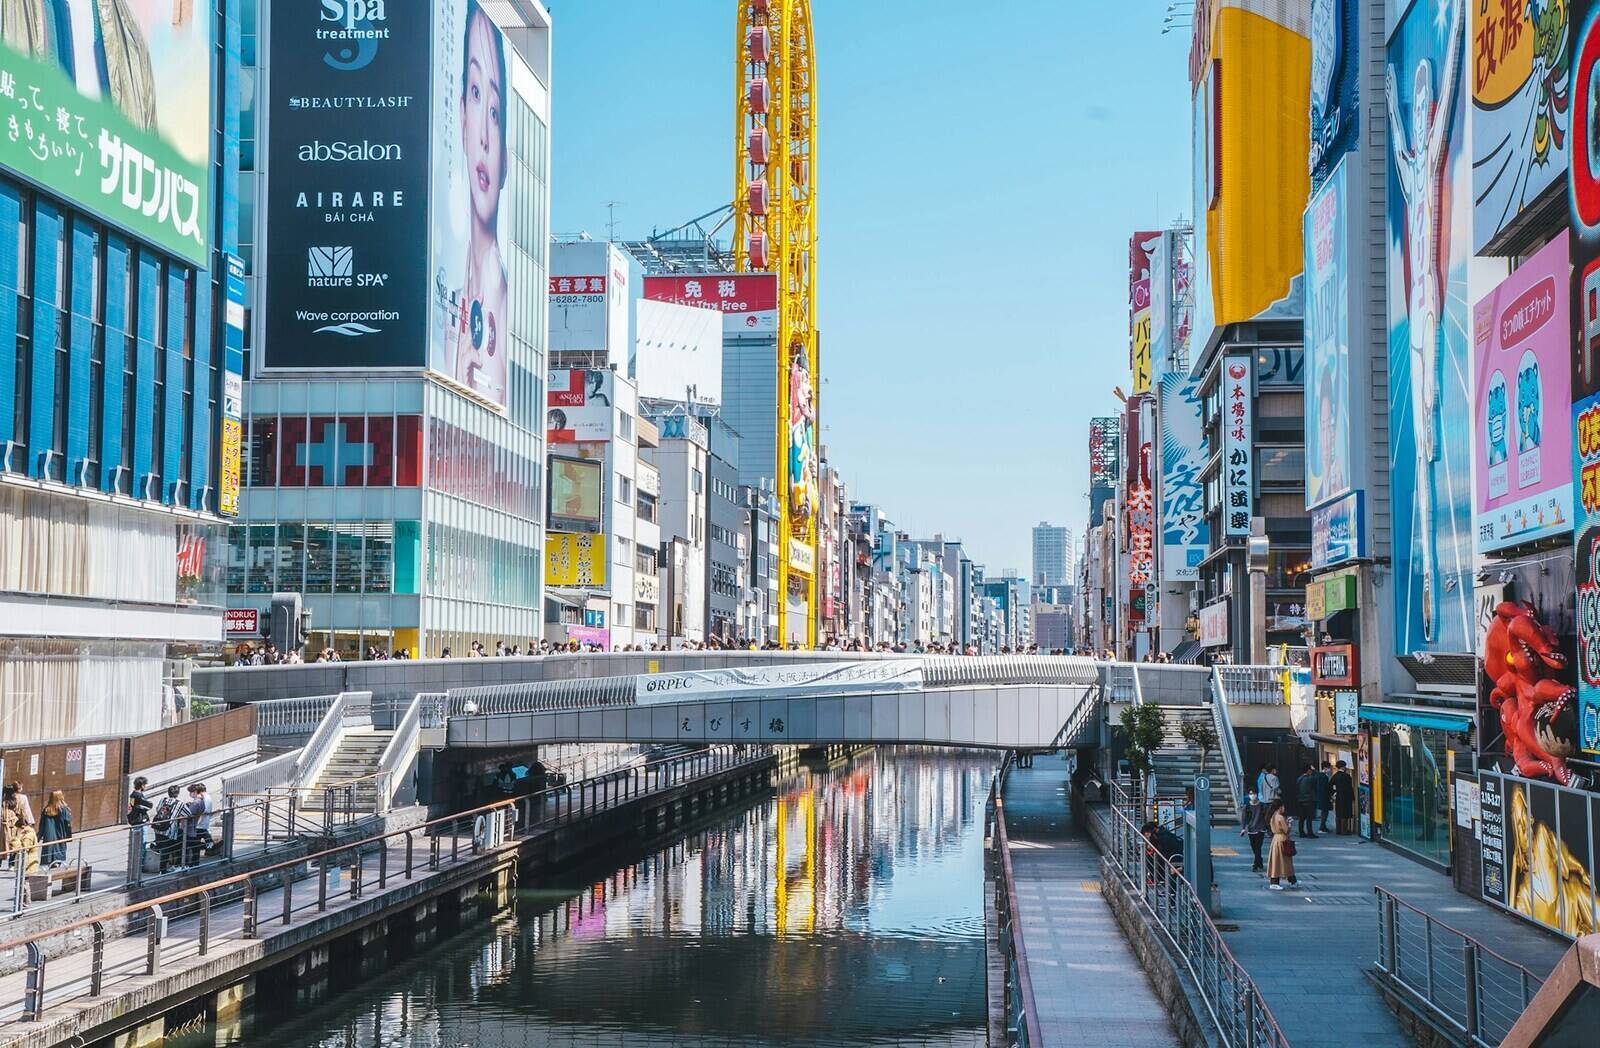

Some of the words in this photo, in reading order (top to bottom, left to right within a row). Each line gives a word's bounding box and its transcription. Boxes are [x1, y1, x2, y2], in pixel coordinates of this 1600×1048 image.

[320, 0, 386, 29] Spa
[316, 28, 389, 39] treatment
[298, 140, 402, 161] abSalon
[98, 127, 204, 246] サロンパス
[296, 191, 404, 208] AIRARE
[308, 276, 352, 287] nature
[721, 300, 747, 311] Free
[296, 311, 328, 321] Wave
[332, 309, 400, 324] corporation
[229, 546, 293, 568] LIFE
[680, 716, 785, 733] えびす橋
